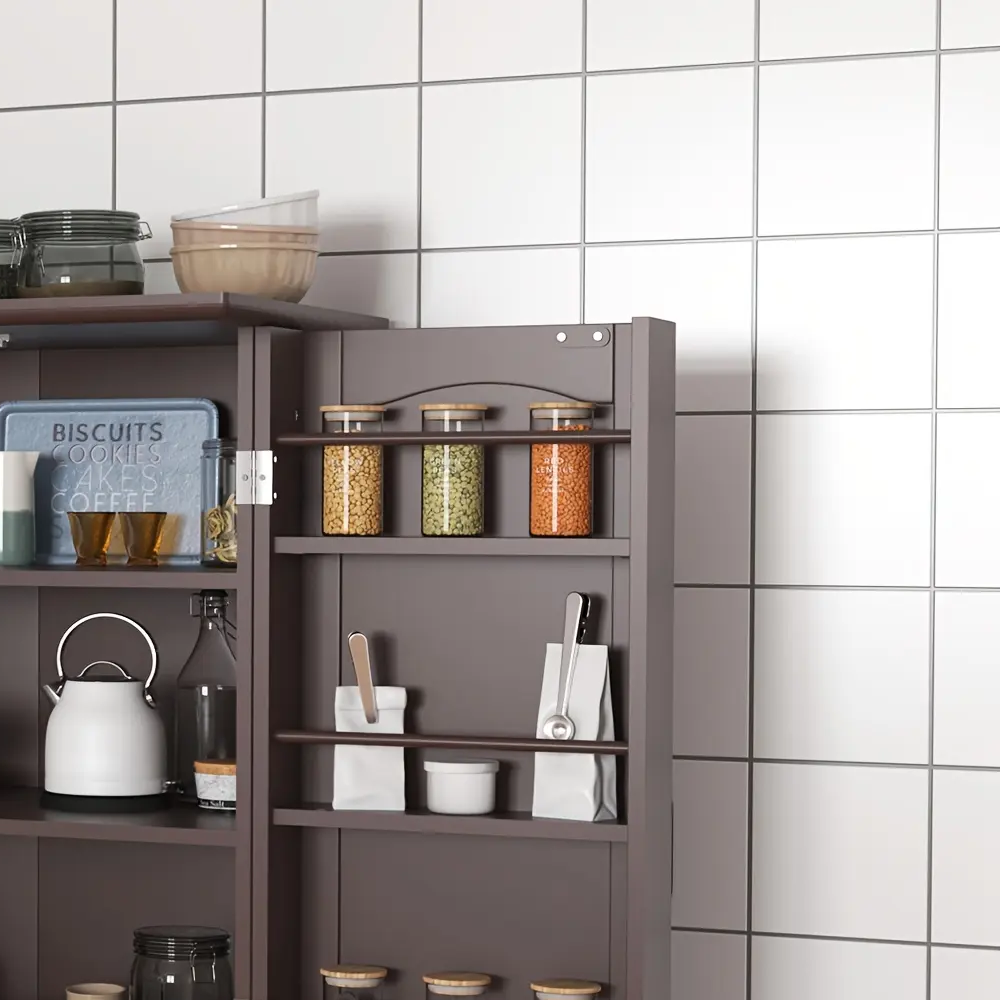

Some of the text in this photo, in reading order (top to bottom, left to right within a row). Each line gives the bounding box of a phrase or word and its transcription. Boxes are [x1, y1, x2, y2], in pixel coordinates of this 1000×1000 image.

[52, 422, 163, 442] BISCUITS
[51, 443, 162, 464] COOKIES
[50, 464, 158, 492] CAKES
[50, 492, 154, 514] COFFEE
[210, 800, 225, 808] Salt
